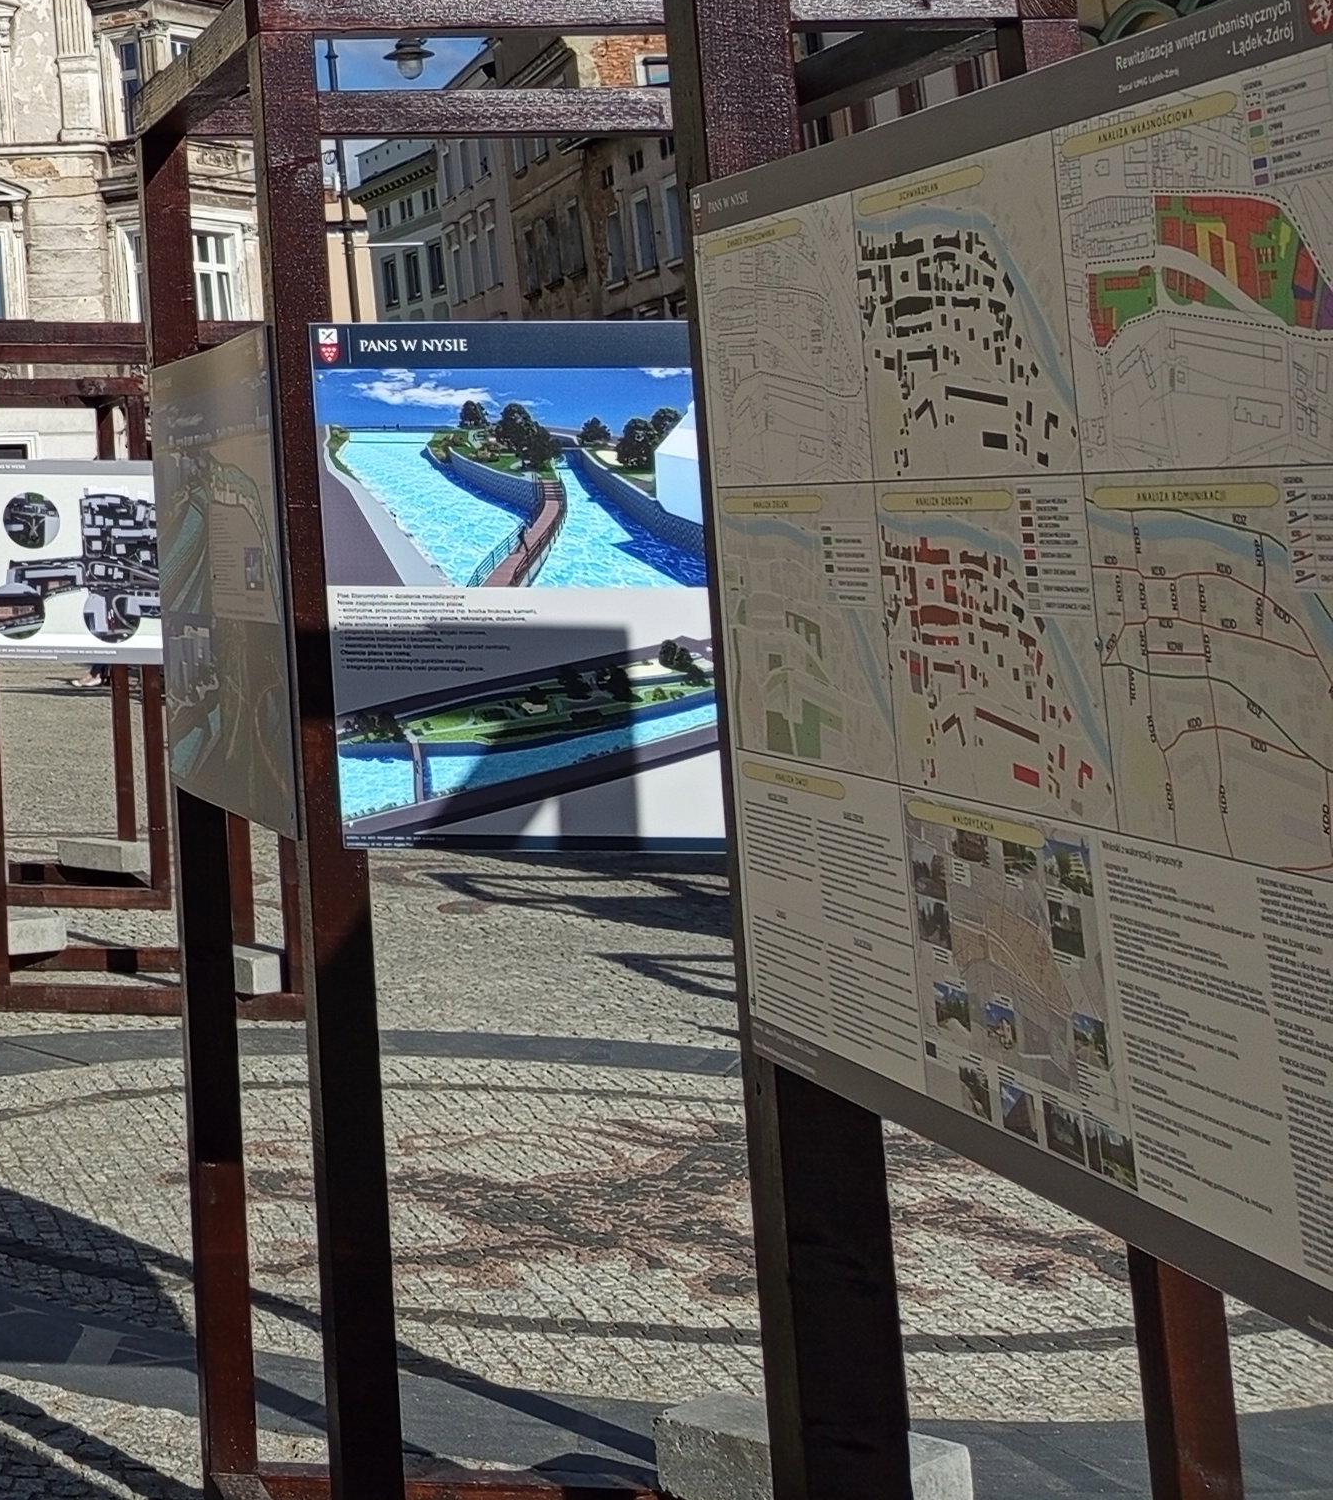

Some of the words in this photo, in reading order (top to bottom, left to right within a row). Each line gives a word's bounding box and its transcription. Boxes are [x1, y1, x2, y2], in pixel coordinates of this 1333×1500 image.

[1115, 39, 1174, 71] Rewitalizacja
[1175, 30, 1208, 50] wnętrz
[1232, 20, 1295, 57] Lądek-Zdrój
[1097, 126, 1129, 144] ANALIZA
[1131, 107, 1194, 135] WŁASNOŚCIOWA
[359, 339, 397, 352] PANS
[400, 339, 417, 352] W
[422, 338, 468, 352] NYSIE
[1137, 491, 1170, 502] ANALIZA
[1171, 489, 1227, 502] KOMUNIKACJI
[952, 813, 995, 833] WALORYZACJA
